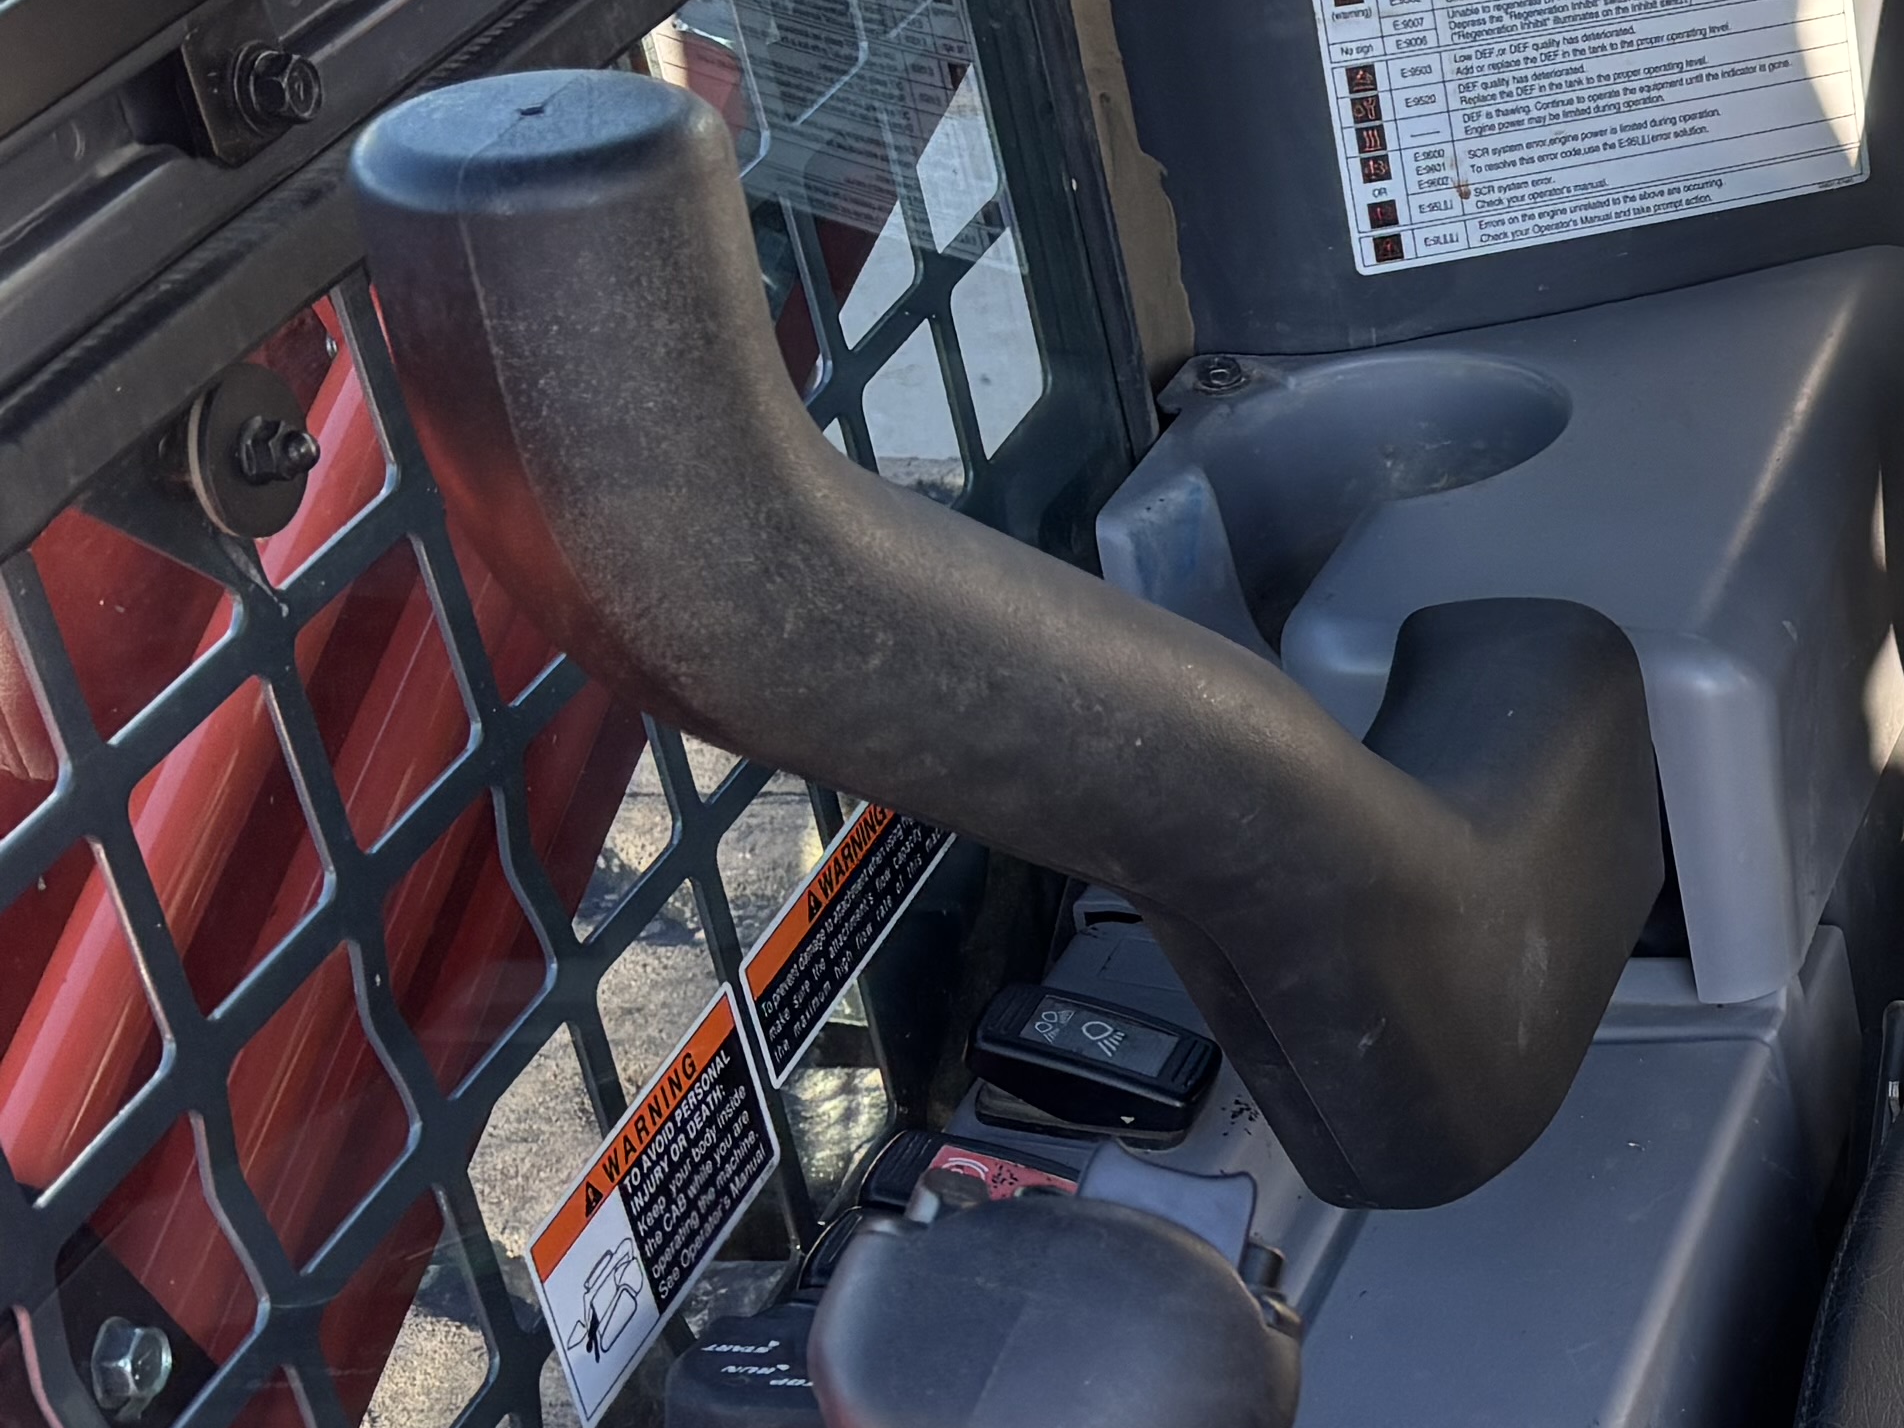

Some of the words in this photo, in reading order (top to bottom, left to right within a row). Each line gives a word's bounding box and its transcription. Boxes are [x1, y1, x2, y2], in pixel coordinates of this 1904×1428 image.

[816, 792, 888, 900] WARNING
[601, 1051, 697, 1183] WARNING
[622, 1166, 641, 1193] TO
[641, 1120, 675, 1173] AVOID
[673, 1049, 730, 1127] PERSONAL
[629, 1154, 669, 1216] INJURY
[669, 1132, 688, 1162] OR
[685, 1084, 725, 1139] DEATH:
[636, 1195, 666, 1237] Keep
[668, 1157, 691, 1198] your
[690, 1124, 717, 1162] body
[715, 1084, 746, 1129] inside
[643, 1229, 663, 1257] the
[662, 1192, 687, 1232] CAB
[686, 1159, 713, 1198] while
[712, 1132, 732, 1167] you
[731, 1109, 749, 1137] are
[651, 1209, 700, 1279] operating
[697, 1186, 715, 1213] the
[715, 1129, 759, 1189] machine.
[657, 1266, 680, 1299] See
[679, 1194, 731, 1268] Operator's
[728, 1141, 766, 1198] Manual
[701, 1342, 771, 1354] START
[720, 1364, 776, 1375] RUN
